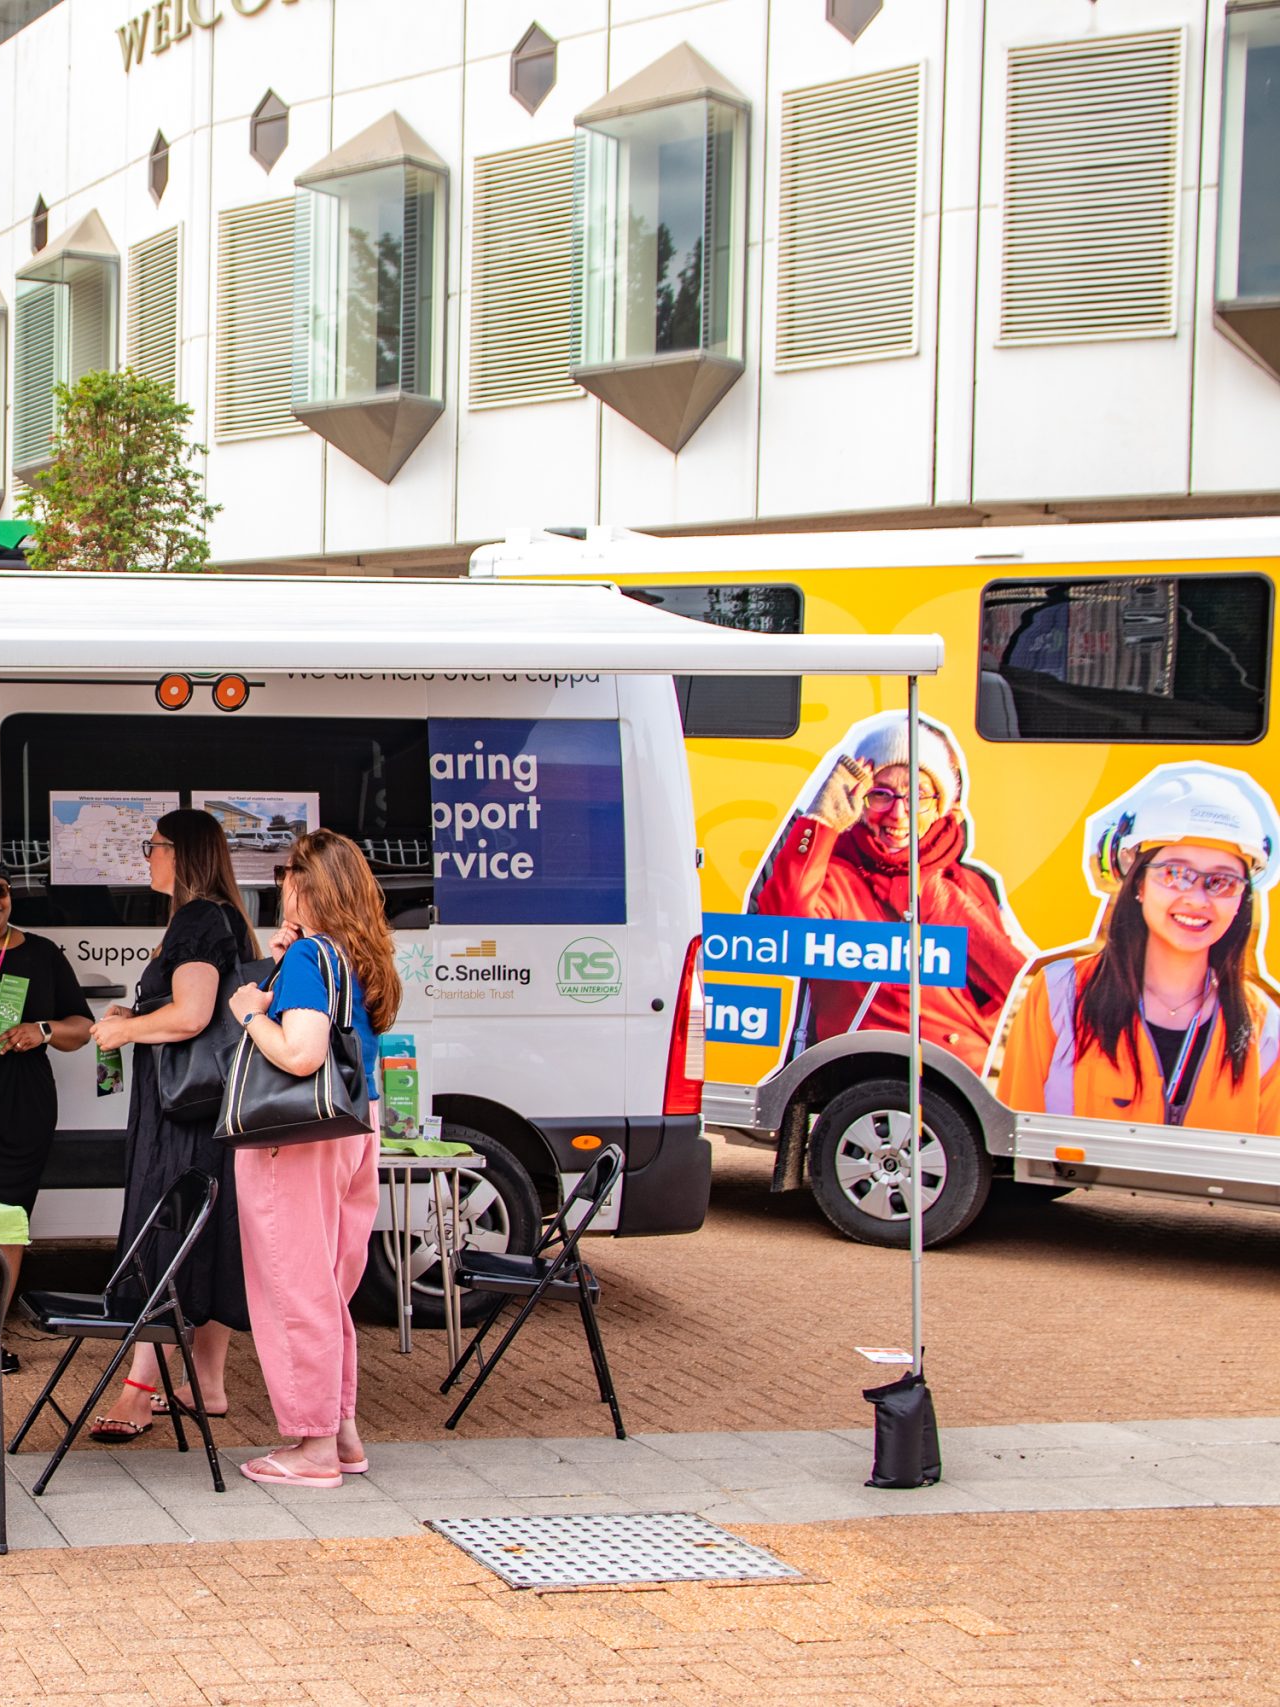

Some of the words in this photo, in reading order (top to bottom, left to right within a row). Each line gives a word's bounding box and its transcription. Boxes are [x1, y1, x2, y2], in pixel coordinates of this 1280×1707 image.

[115, 0, 298, 73] WELC
[429, 740, 538, 792] aring
[431, 795, 541, 841] pport
[433, 838, 534, 880] rvice
[77, 940, 155, 966] Suppo
[704, 930, 789, 964] onal
[435, 964, 531, 984] C.Snelling
[564, 951, 614, 980] RS
[433, 989, 485, 1000] Charitable
[489, 989, 515, 1000] Trust
[561, 985, 578, 994] VAN
[580, 985, 619, 994] INTERIORS
[705, 997, 768, 1040] ing
